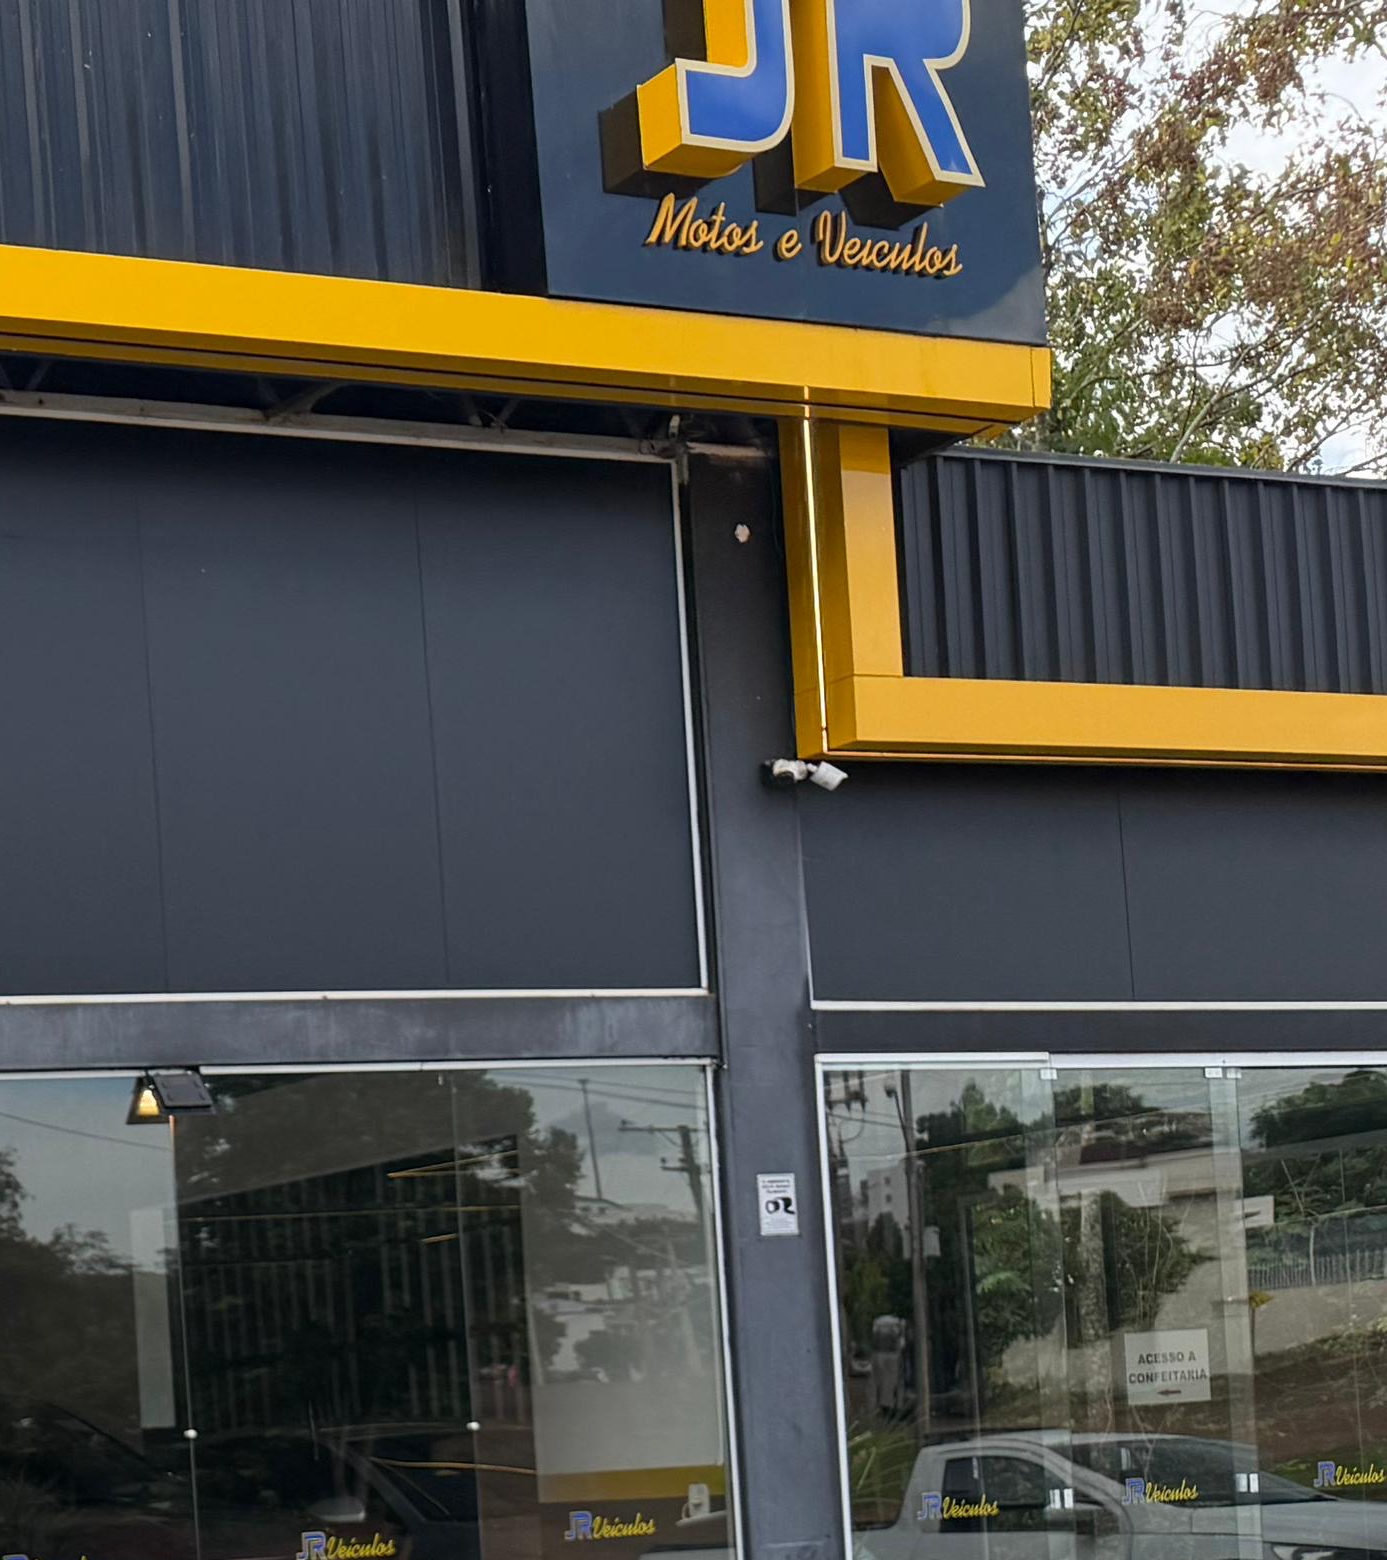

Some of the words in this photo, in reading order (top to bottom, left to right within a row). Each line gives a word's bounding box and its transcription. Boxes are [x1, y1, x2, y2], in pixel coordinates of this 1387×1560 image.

[667, 0, 985, 190] JR
[645, 192, 764, 254] Motos
[778, 227, 803, 258] e
[1138, 1352, 1184, 1365] ACESSO
[1188, 1350, 1196, 1362] A
[1128, 1368, 1207, 1384] CONFEITARIA
[1313, 1461, 1336, 1488] JR
[1122, 1477, 1145, 1505] JR
[917, 1491, 943, 1520] JR
[564, 1511, 593, 1541] JR
